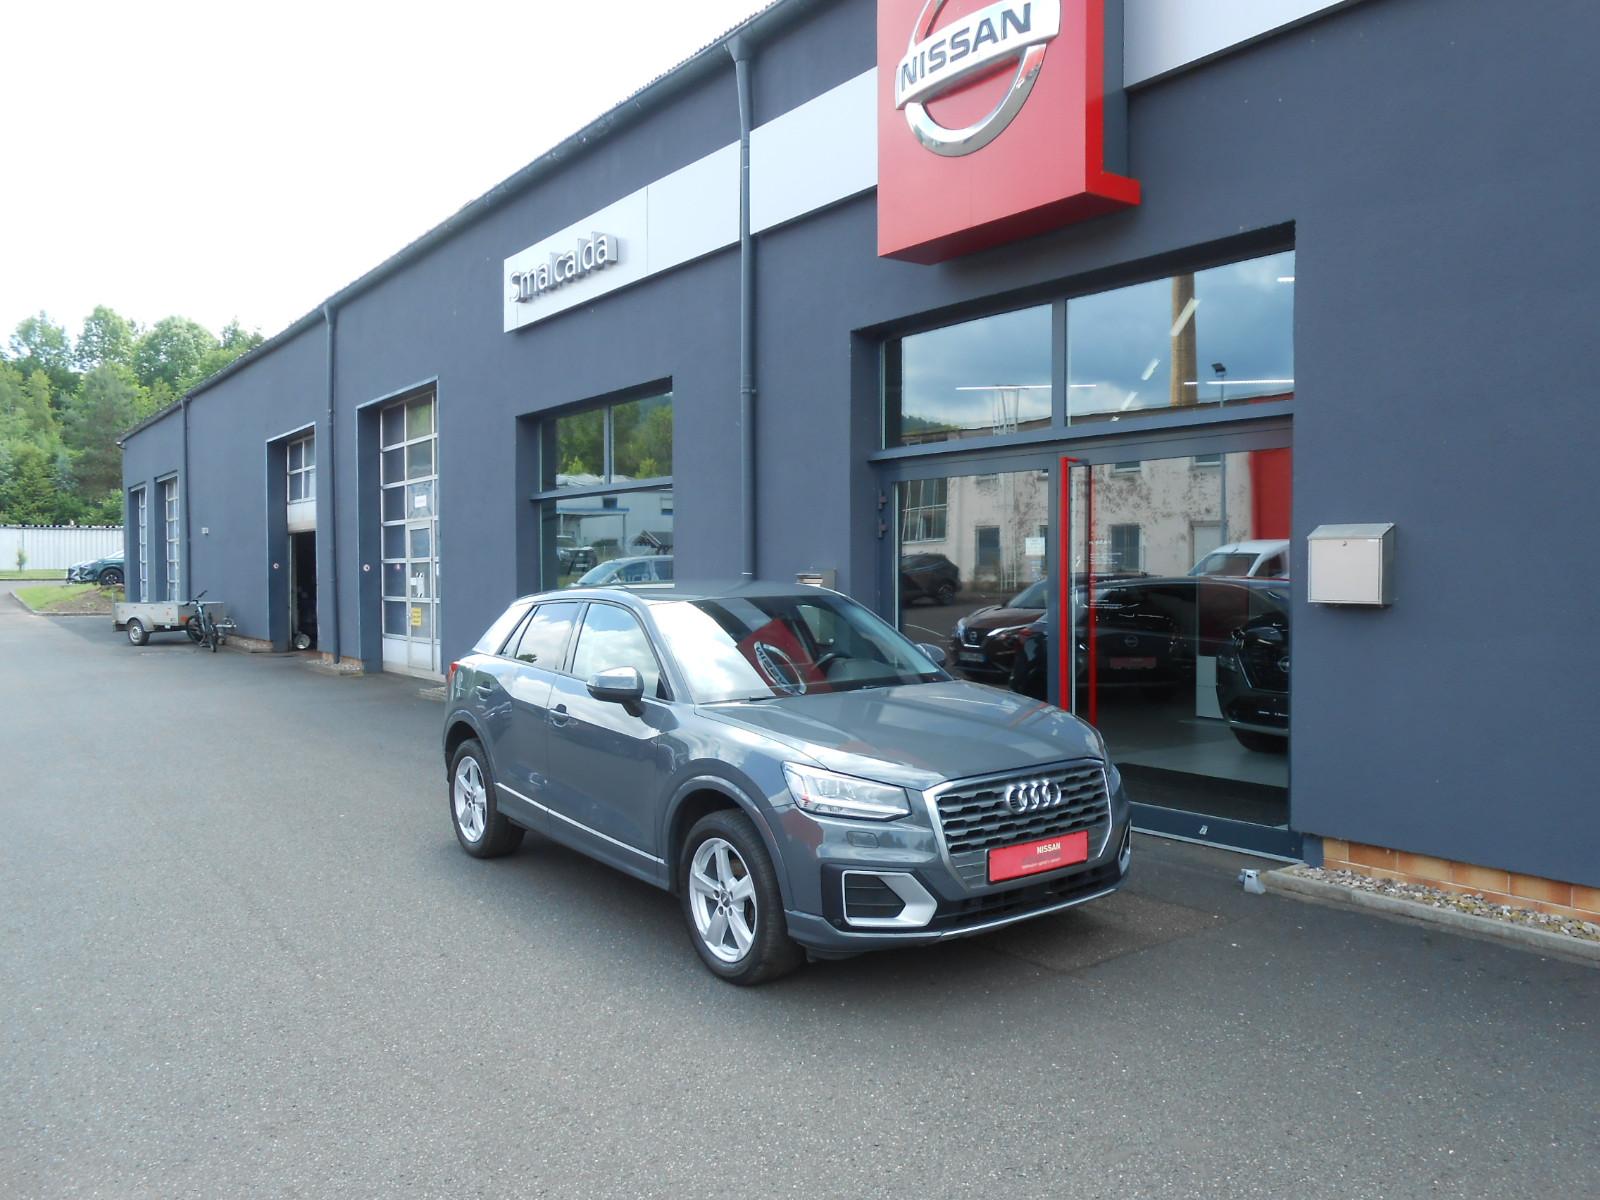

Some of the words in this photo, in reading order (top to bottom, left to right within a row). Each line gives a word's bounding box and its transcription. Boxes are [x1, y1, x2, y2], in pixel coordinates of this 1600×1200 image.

[901, 3, 1031, 91] NISSAN
[510, 231, 614, 302] Smalcalda
[1036, 842, 1061, 854] NISSAN
